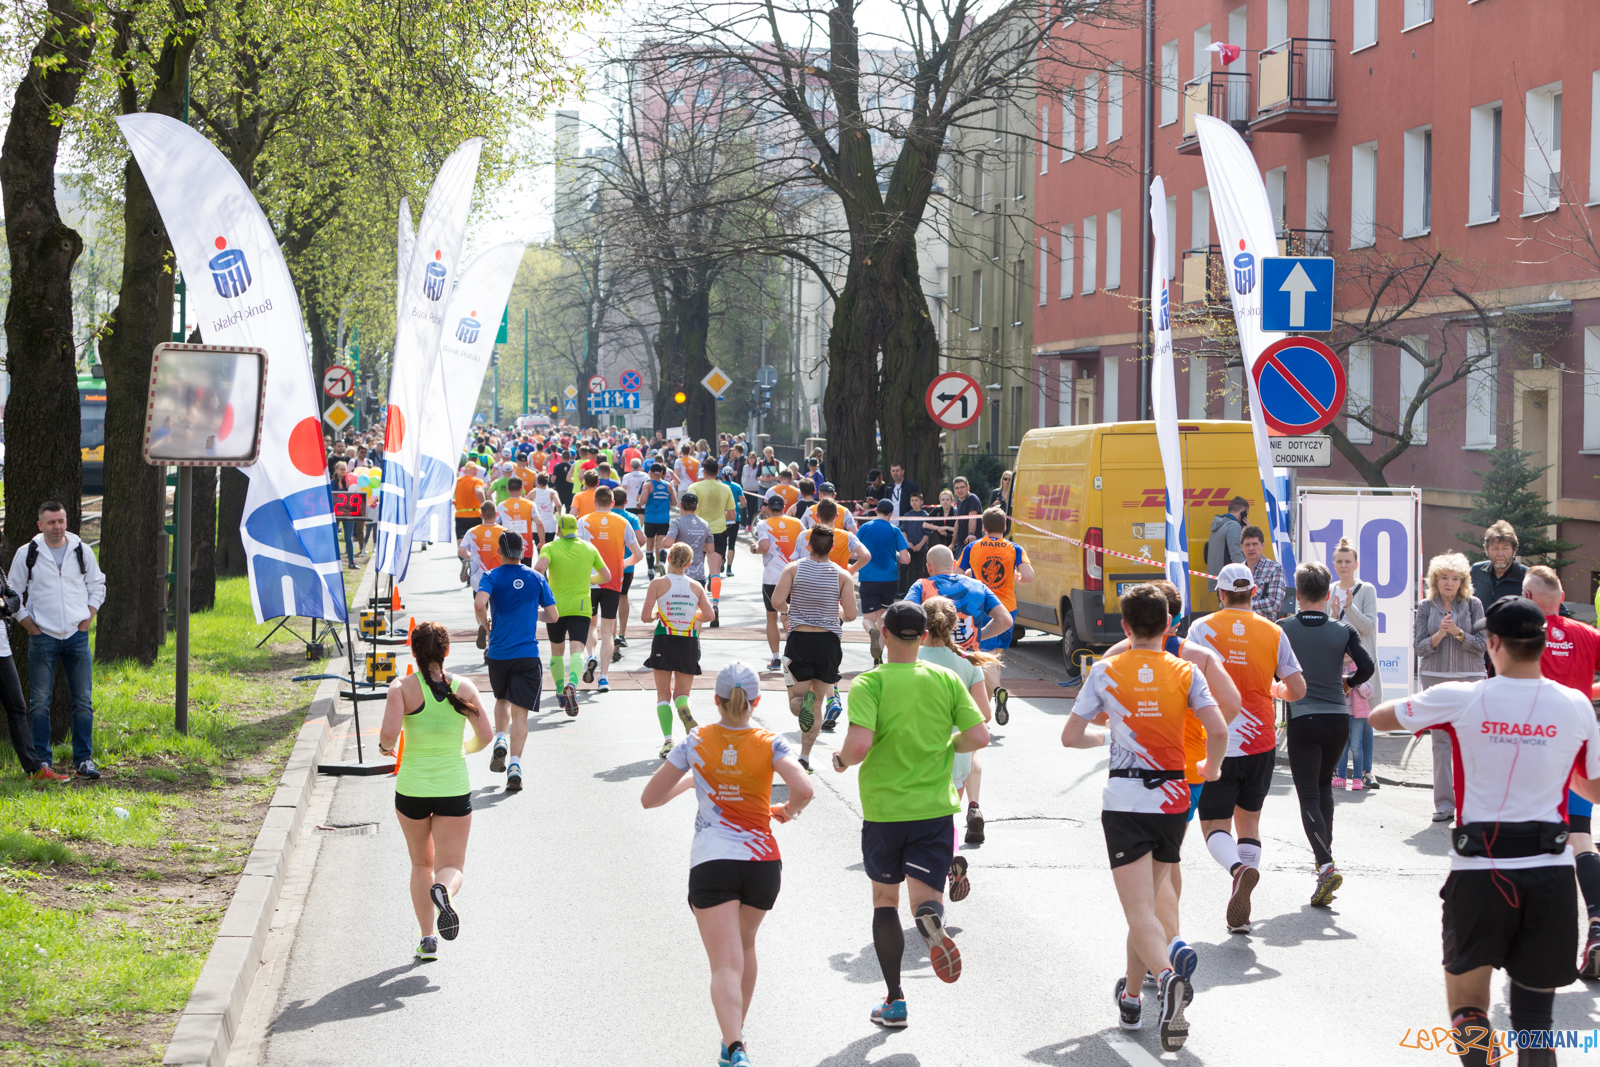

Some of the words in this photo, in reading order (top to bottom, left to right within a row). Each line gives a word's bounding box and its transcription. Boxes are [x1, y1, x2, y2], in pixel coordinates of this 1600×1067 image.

[1270, 441, 1282, 449] NIE
[1288, 441, 1323, 450] DOTYCZY
[1275, 454, 1315, 463] CHODNIKA
[334, 493, 362, 516] 29
[1034, 484, 1072, 521] DHL
[1309, 518, 1408, 599] 10
[1545, 641, 1574, 649] nordic
[1481, 721, 1557, 738] STRABAG
[1489, 736, 1520, 745] TEAMS
